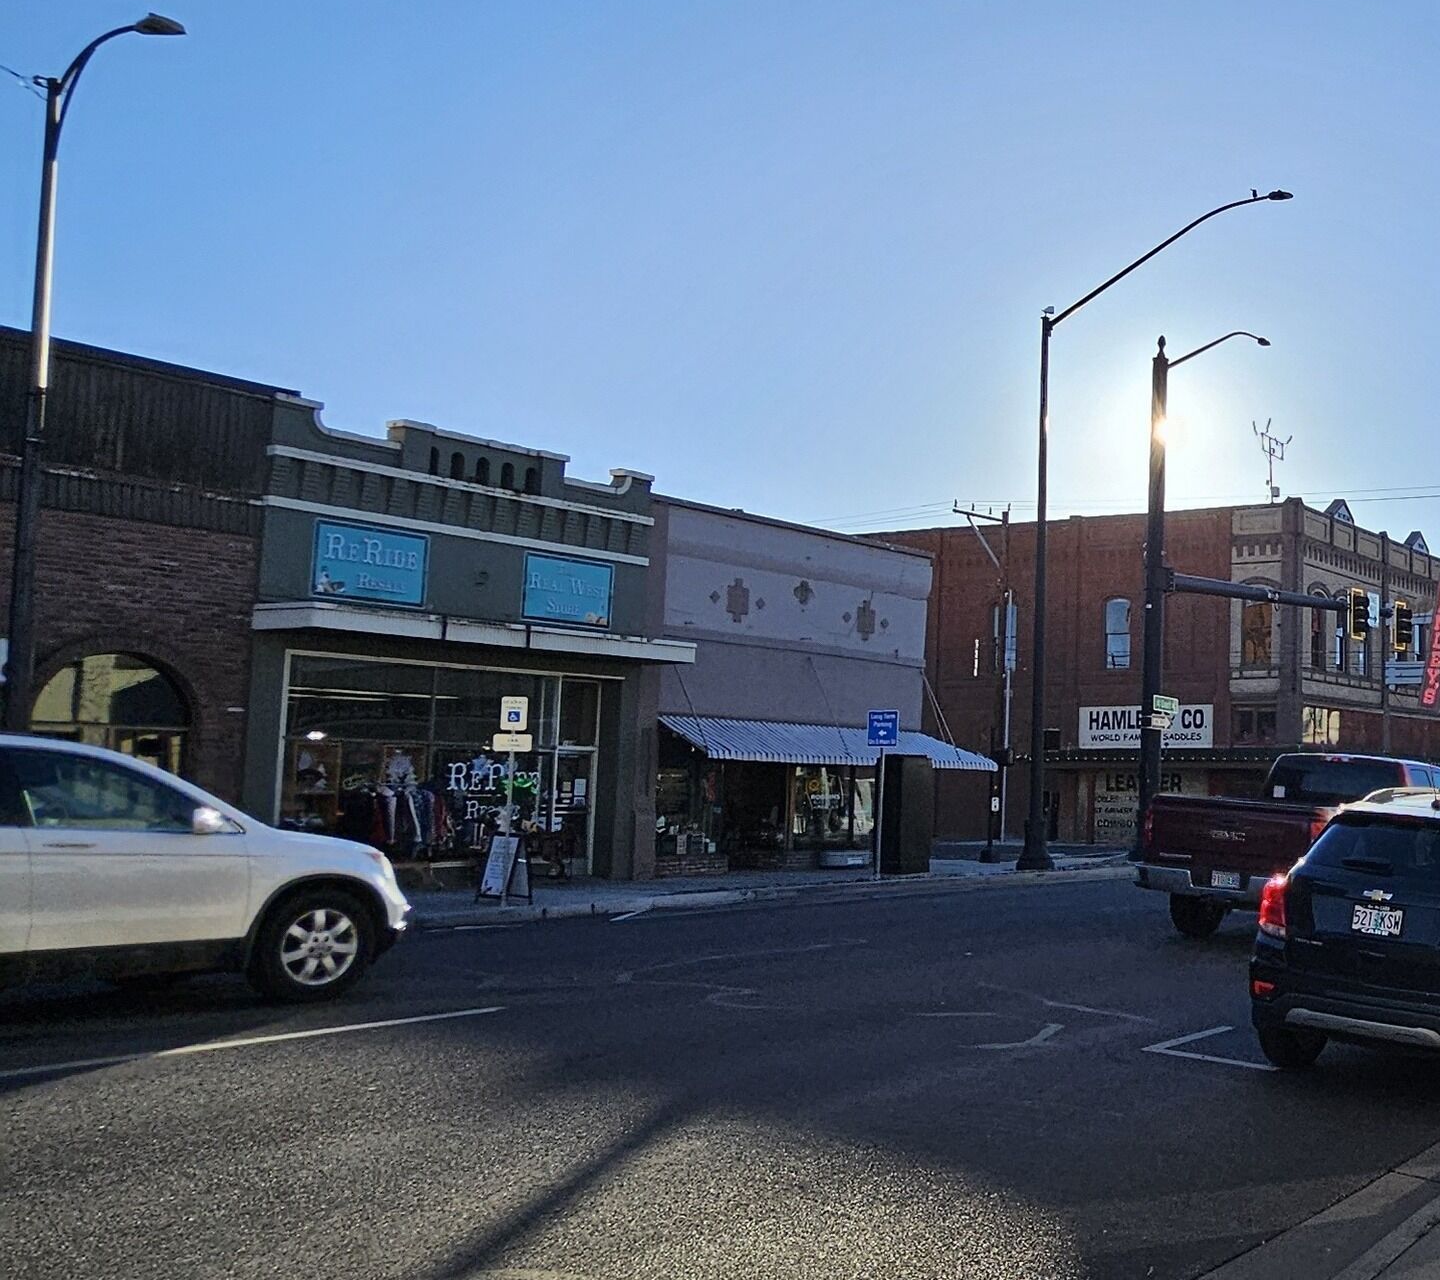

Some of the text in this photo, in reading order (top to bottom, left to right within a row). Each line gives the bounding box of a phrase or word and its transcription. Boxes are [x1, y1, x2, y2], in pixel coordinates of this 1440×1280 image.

[1181, 708, 1208, 729] CO.
[1091, 733, 1121, 742] WORLD
[1162, 732, 1203, 741] SADDLES
[1106, 773, 1182, 792] LEAER
[1353, 909, 1373, 927] 521
